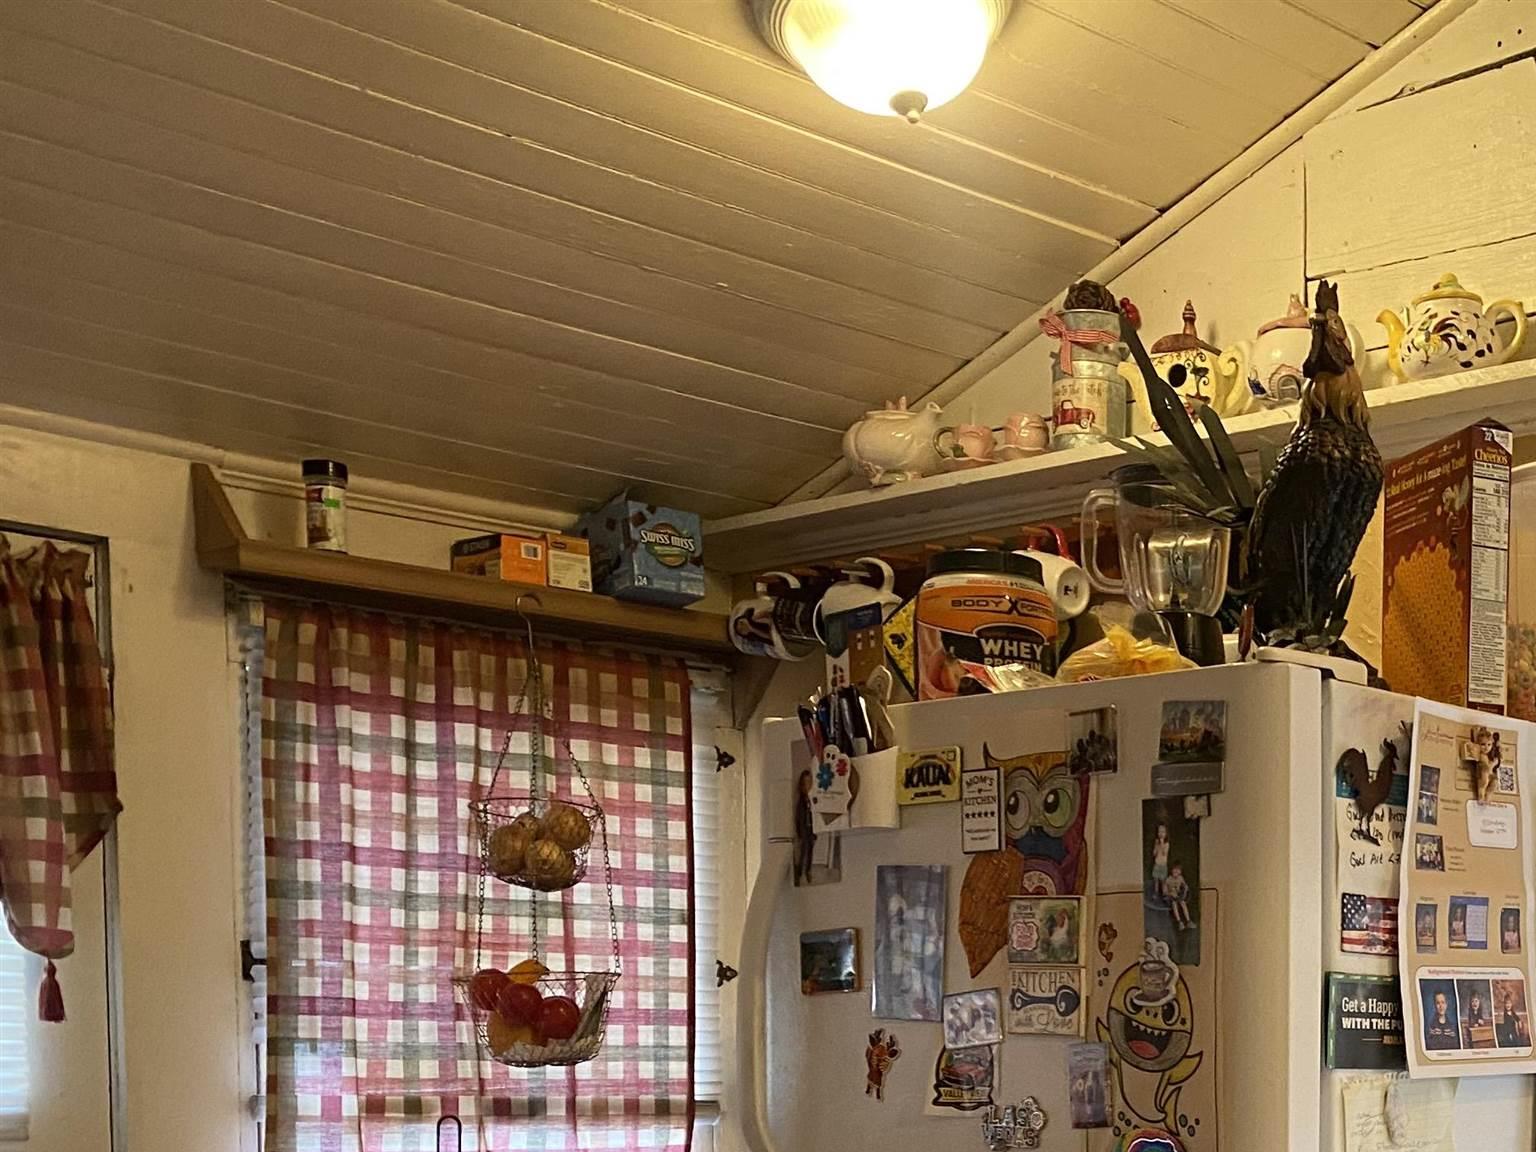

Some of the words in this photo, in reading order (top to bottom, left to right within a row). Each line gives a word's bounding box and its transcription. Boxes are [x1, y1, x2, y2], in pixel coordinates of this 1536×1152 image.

[1475, 448, 1508, 464] Cheerios
[951, 599, 1003, 608] BODY
[980, 638, 1044, 660] WHEY
[1016, 970, 1076, 994] KITCHEN
[1341, 996, 1358, 1013] Get
[1360, 1001, 1367, 1013] a
[1341, 1016, 1370, 1030] WITH
[1371, 1018, 1391, 1030] THE
